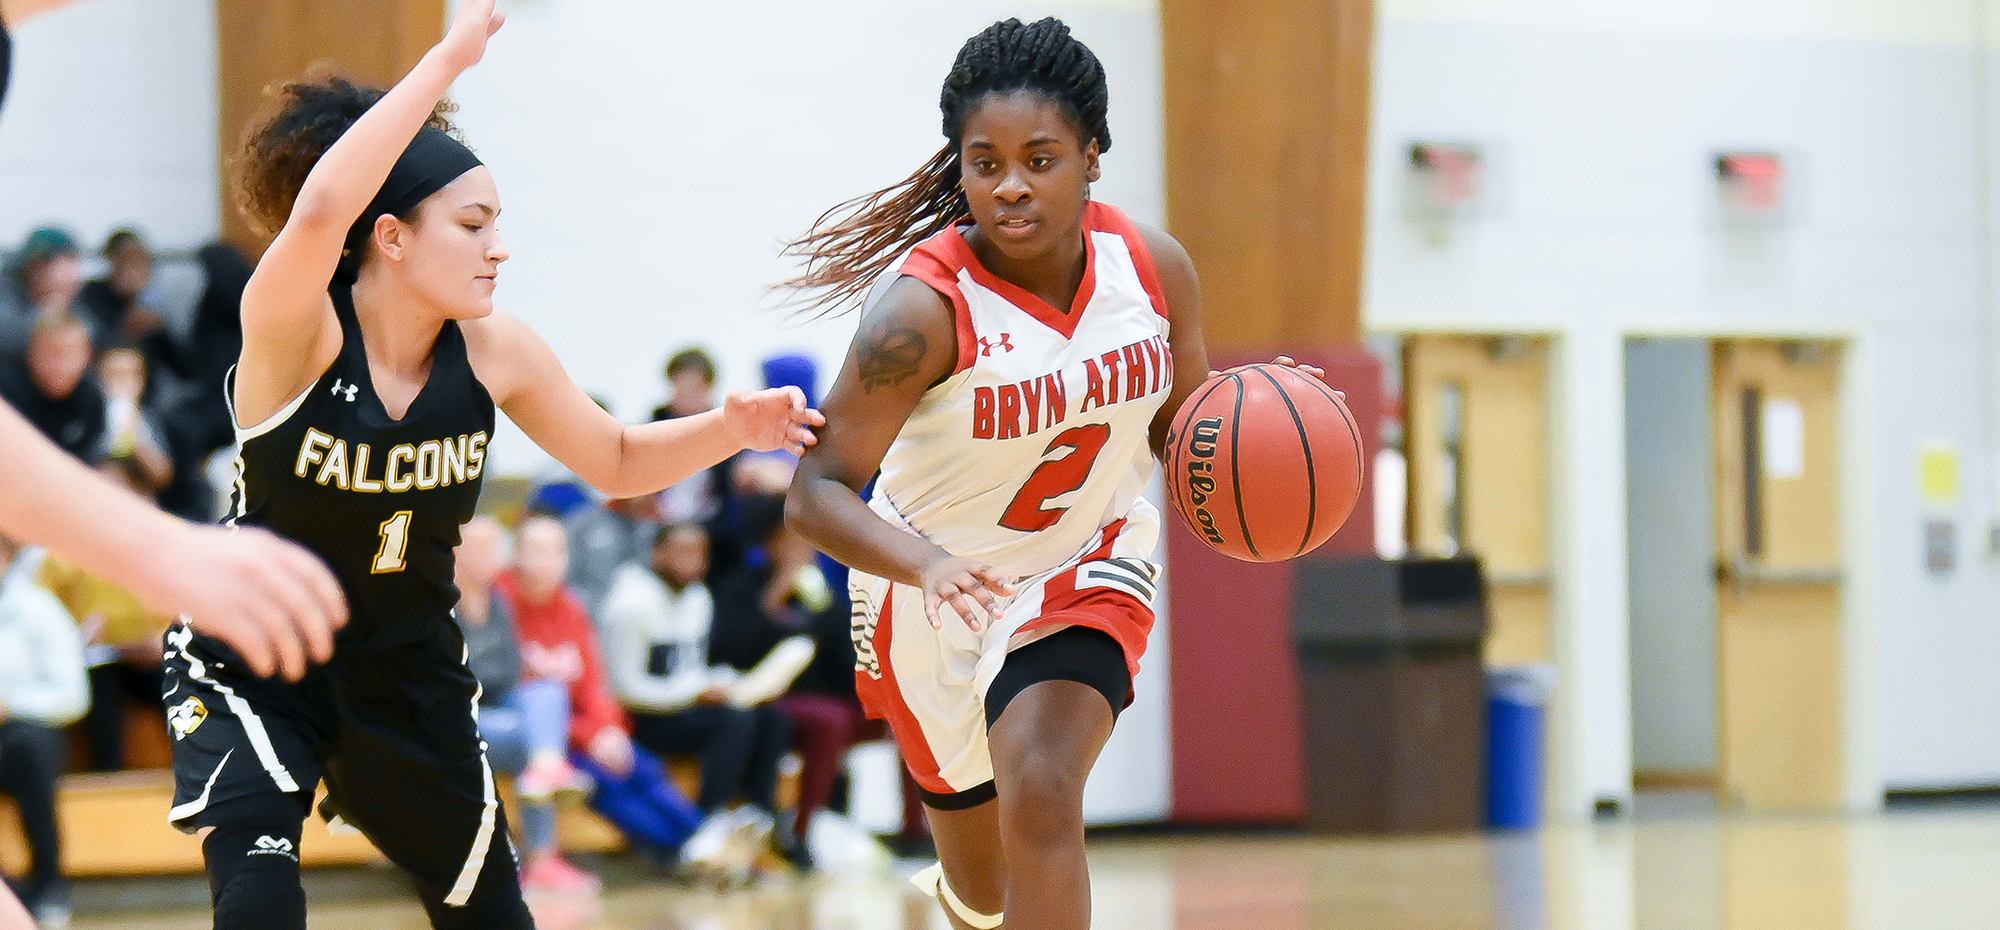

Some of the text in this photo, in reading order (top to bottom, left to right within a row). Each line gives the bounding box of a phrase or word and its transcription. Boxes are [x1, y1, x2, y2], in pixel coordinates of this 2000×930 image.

[972, 369, 1067, 440] BRYN
[294, 427, 488, 493] FALCONS
[997, 421, 1112, 533] 2
[1188, 416, 1224, 544] Wilson
[370, 510, 413, 575] 1
